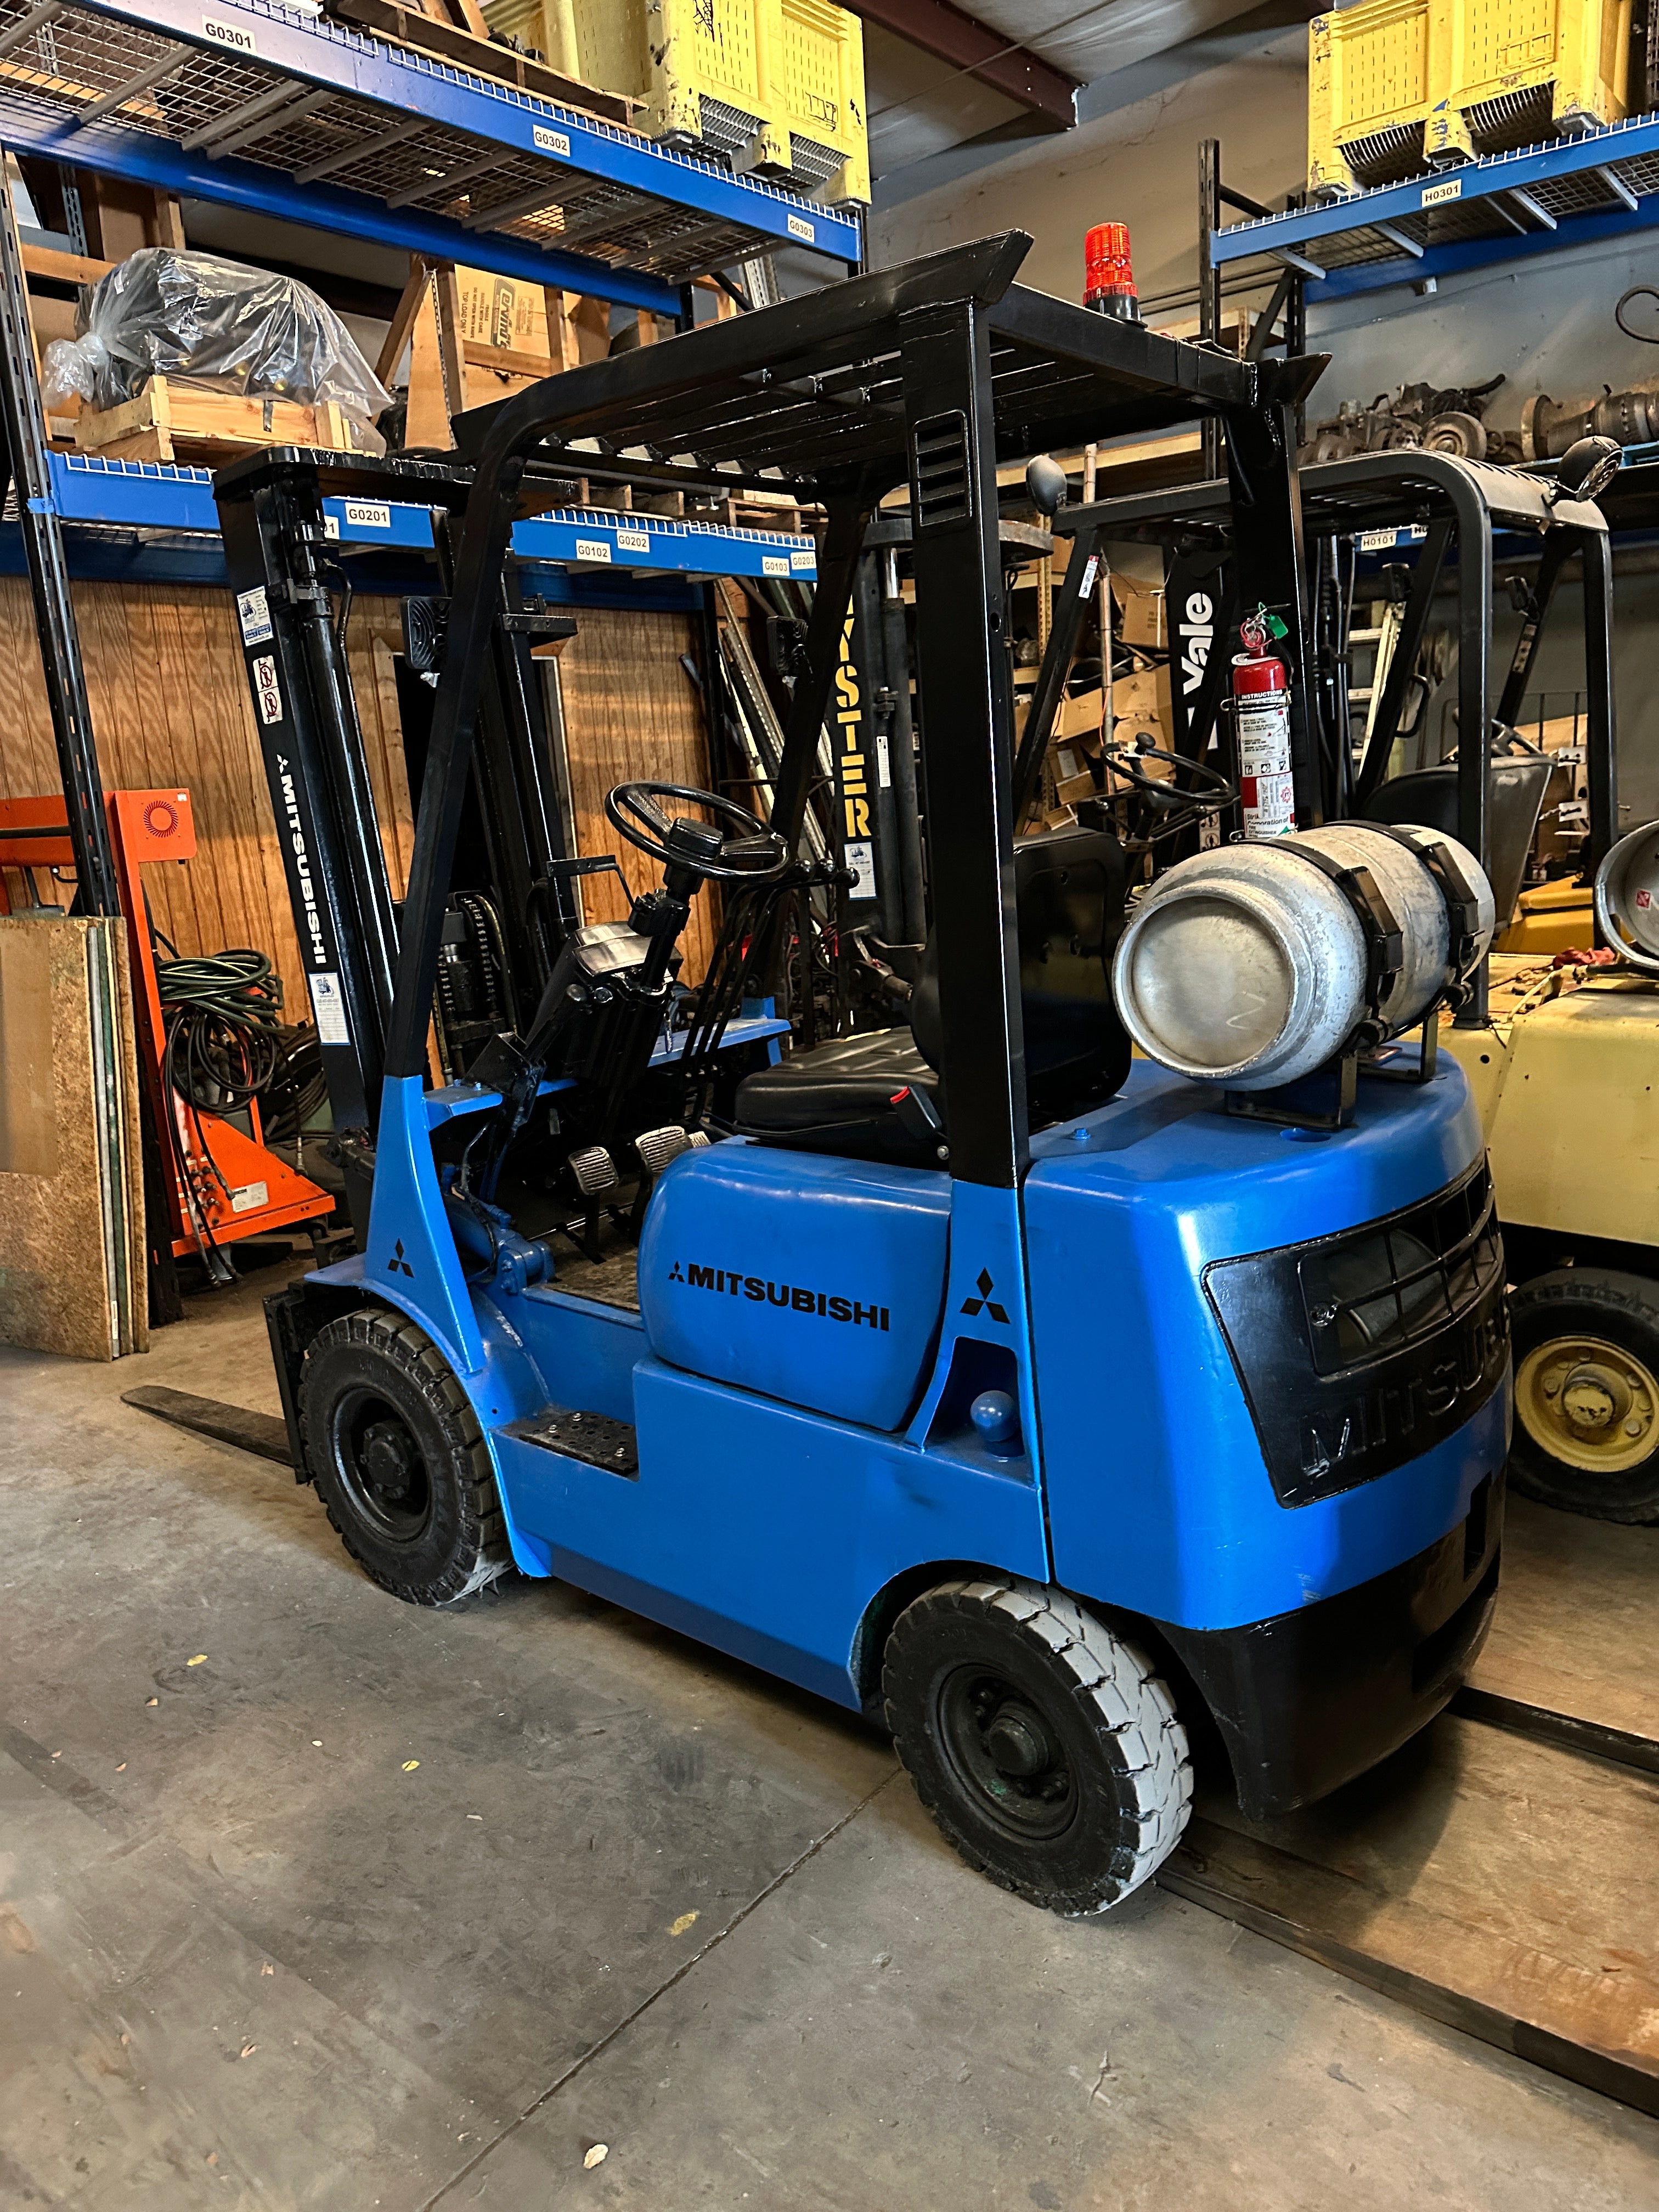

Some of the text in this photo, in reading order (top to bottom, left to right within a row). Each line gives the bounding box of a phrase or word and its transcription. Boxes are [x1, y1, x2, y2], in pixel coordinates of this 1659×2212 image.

[205, 23, 251, 48] G0301
[535, 131, 567, 151] G0302
[1425, 184, 1458, 202] H0301
[790, 220, 812, 238] G0303
[349, 509, 387, 522] G0201
[618, 535, 646, 547] G0202
[1363, 535, 1394, 546] H0101
[578, 545, 608, 557] G0102
[765, 562, 787, 571] G0103
[793, 556, 814, 566] G0203
[1179, 592, 1213, 695] Yale
[1242, 689, 1283, 699] INSTRUCTIONS
[836, 594, 872, 837] YSTER
[280, 774, 327, 964] MITSUBISHI
[688, 1263, 889, 1332] MITSUBISHI
